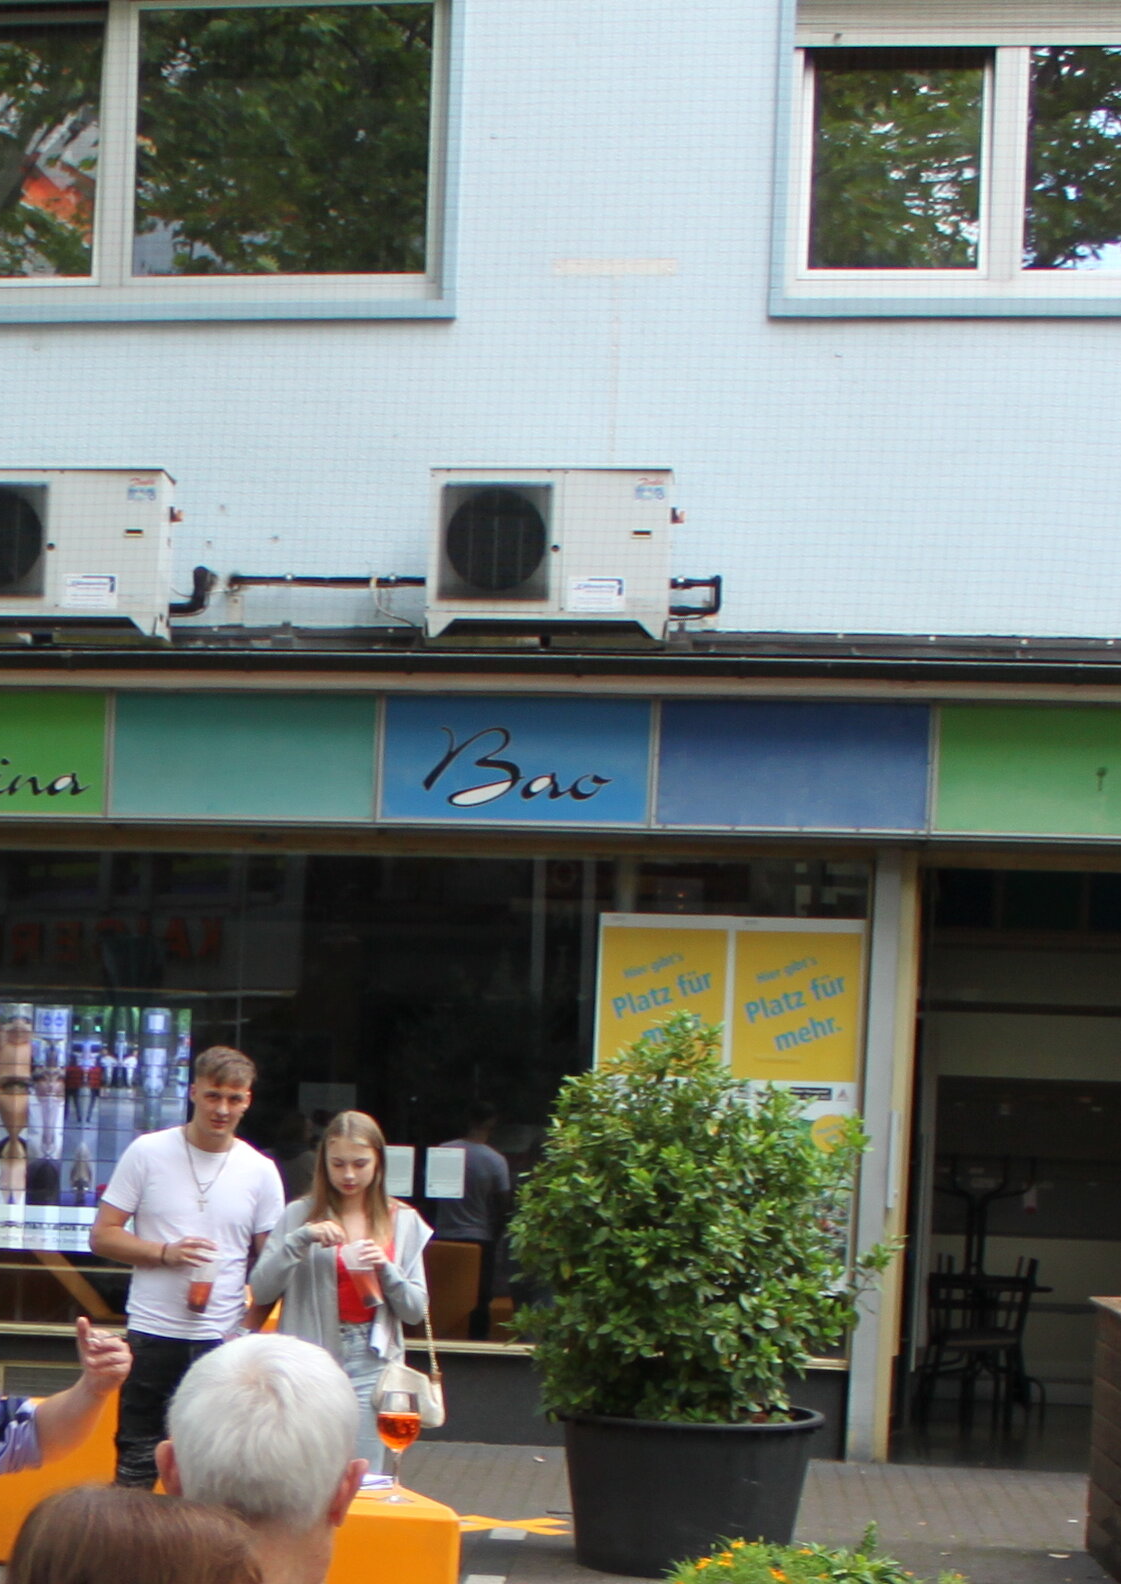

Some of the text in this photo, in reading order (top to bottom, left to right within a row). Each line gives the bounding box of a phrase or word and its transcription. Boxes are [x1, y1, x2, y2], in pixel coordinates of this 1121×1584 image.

[422, 726, 613, 808] Bao
[611, 970, 713, 1019] Platz für
[744, 975, 846, 1024] Platz für
[773, 1017, 843, 1052] mehr.
